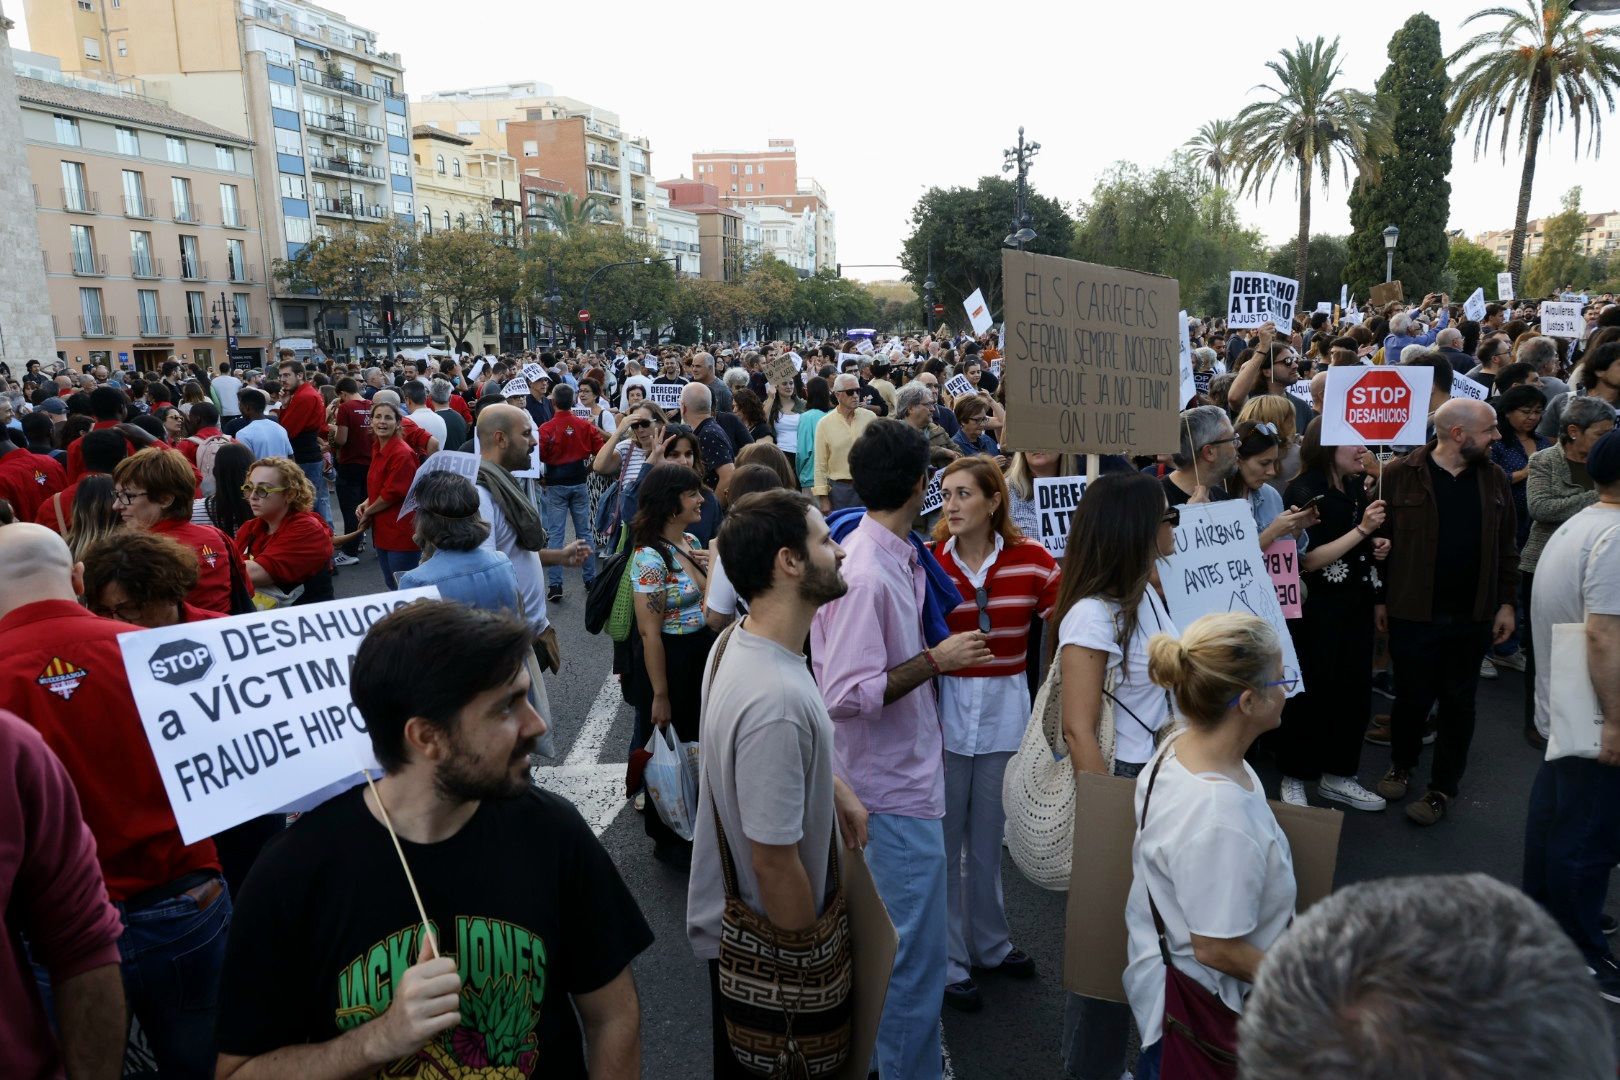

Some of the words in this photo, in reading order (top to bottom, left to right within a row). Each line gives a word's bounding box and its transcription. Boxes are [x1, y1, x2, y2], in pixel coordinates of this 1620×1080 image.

[1025, 272, 1065, 317] ELS
[1075, 281, 1158, 329] CARRERS
[1233, 276, 1295, 301] DERECHO
[1230, 314, 1237, 323] A
[1238, 313, 1268, 323] JUSTO
[1231, 296, 1241, 313] A
[1244, 296, 1291, 320] TECHO
[1016, 321, 1068, 364] SERAN
[1073, 328, 1121, 370] SEMPRE
[1124, 334, 1173, 376] NOSTRES
[1029, 366, 1087, 408] PERQUÈ
[1095, 373, 1109, 405] JA
[1114, 376, 1131, 406] NO
[1136, 377, 1170, 411] TENIM
[1290, 382, 1312, 396] Alqui
[1352, 386, 1407, 404] STOP
[1453, 377, 1481, 401] quileres.
[1059, 410, 1086, 444] ON
[1095, 412, 1137, 446] VIURE
[1349, 408, 1407, 423] DESAHUCIOS
[1042, 512, 1054, 537] A
[1045, 538, 1051, 550] A
[1283, 552, 1293, 573] A
[1184, 562, 1224, 595] ANTES
[1227, 559, 1254, 581] ERA
[150, 648, 210, 679] STOP
[158, 708, 186, 741] a
[190, 654, 358, 722] VÍCTIM
[174, 720, 301, 802] FRAUDE
[456, 916, 547, 1005] JONES
